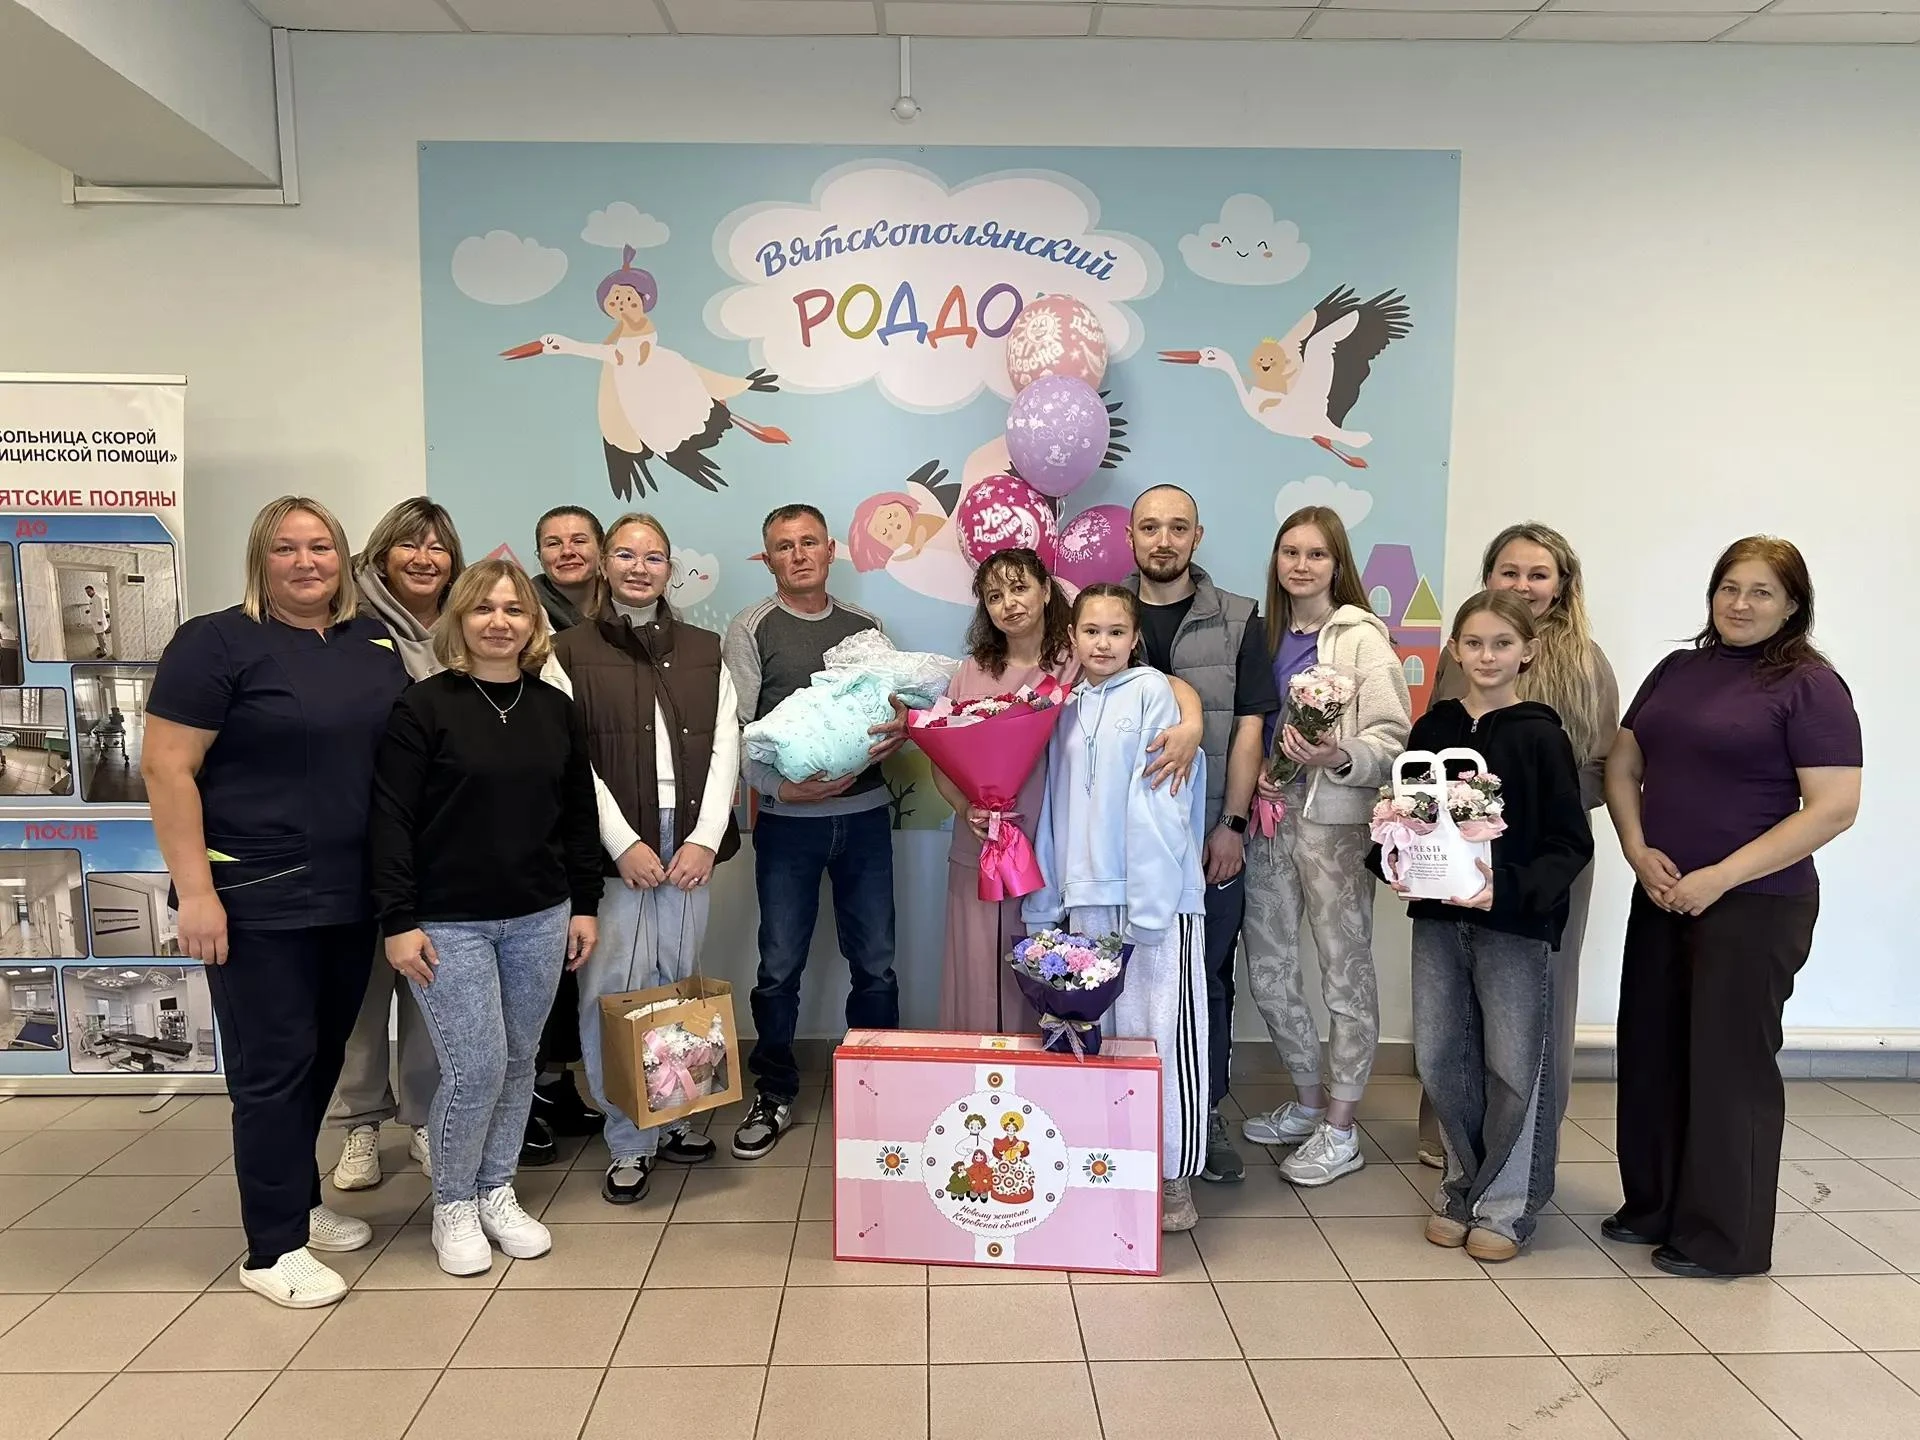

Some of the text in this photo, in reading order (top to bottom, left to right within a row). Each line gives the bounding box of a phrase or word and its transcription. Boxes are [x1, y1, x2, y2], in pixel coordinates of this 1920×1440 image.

[755, 219, 1118, 281] Вятскополянский
[793, 281, 1023, 349] РОДДО
[92, 428, 156, 444] СКОРОЙ
[97, 449, 178, 464] ПОМОЩИ»
[90, 490, 176, 507] ПОЛЯНЫ
[980, 503, 1013, 531] Ура
[16, 519, 48, 538] ДО
[973, 516, 1021, 543] Девочка
[24, 823, 99, 841] ПОСЛЕ
[952, 1212, 1037, 1230] Кировской области
[960, 1205, 1029, 1221] Новому жителю
